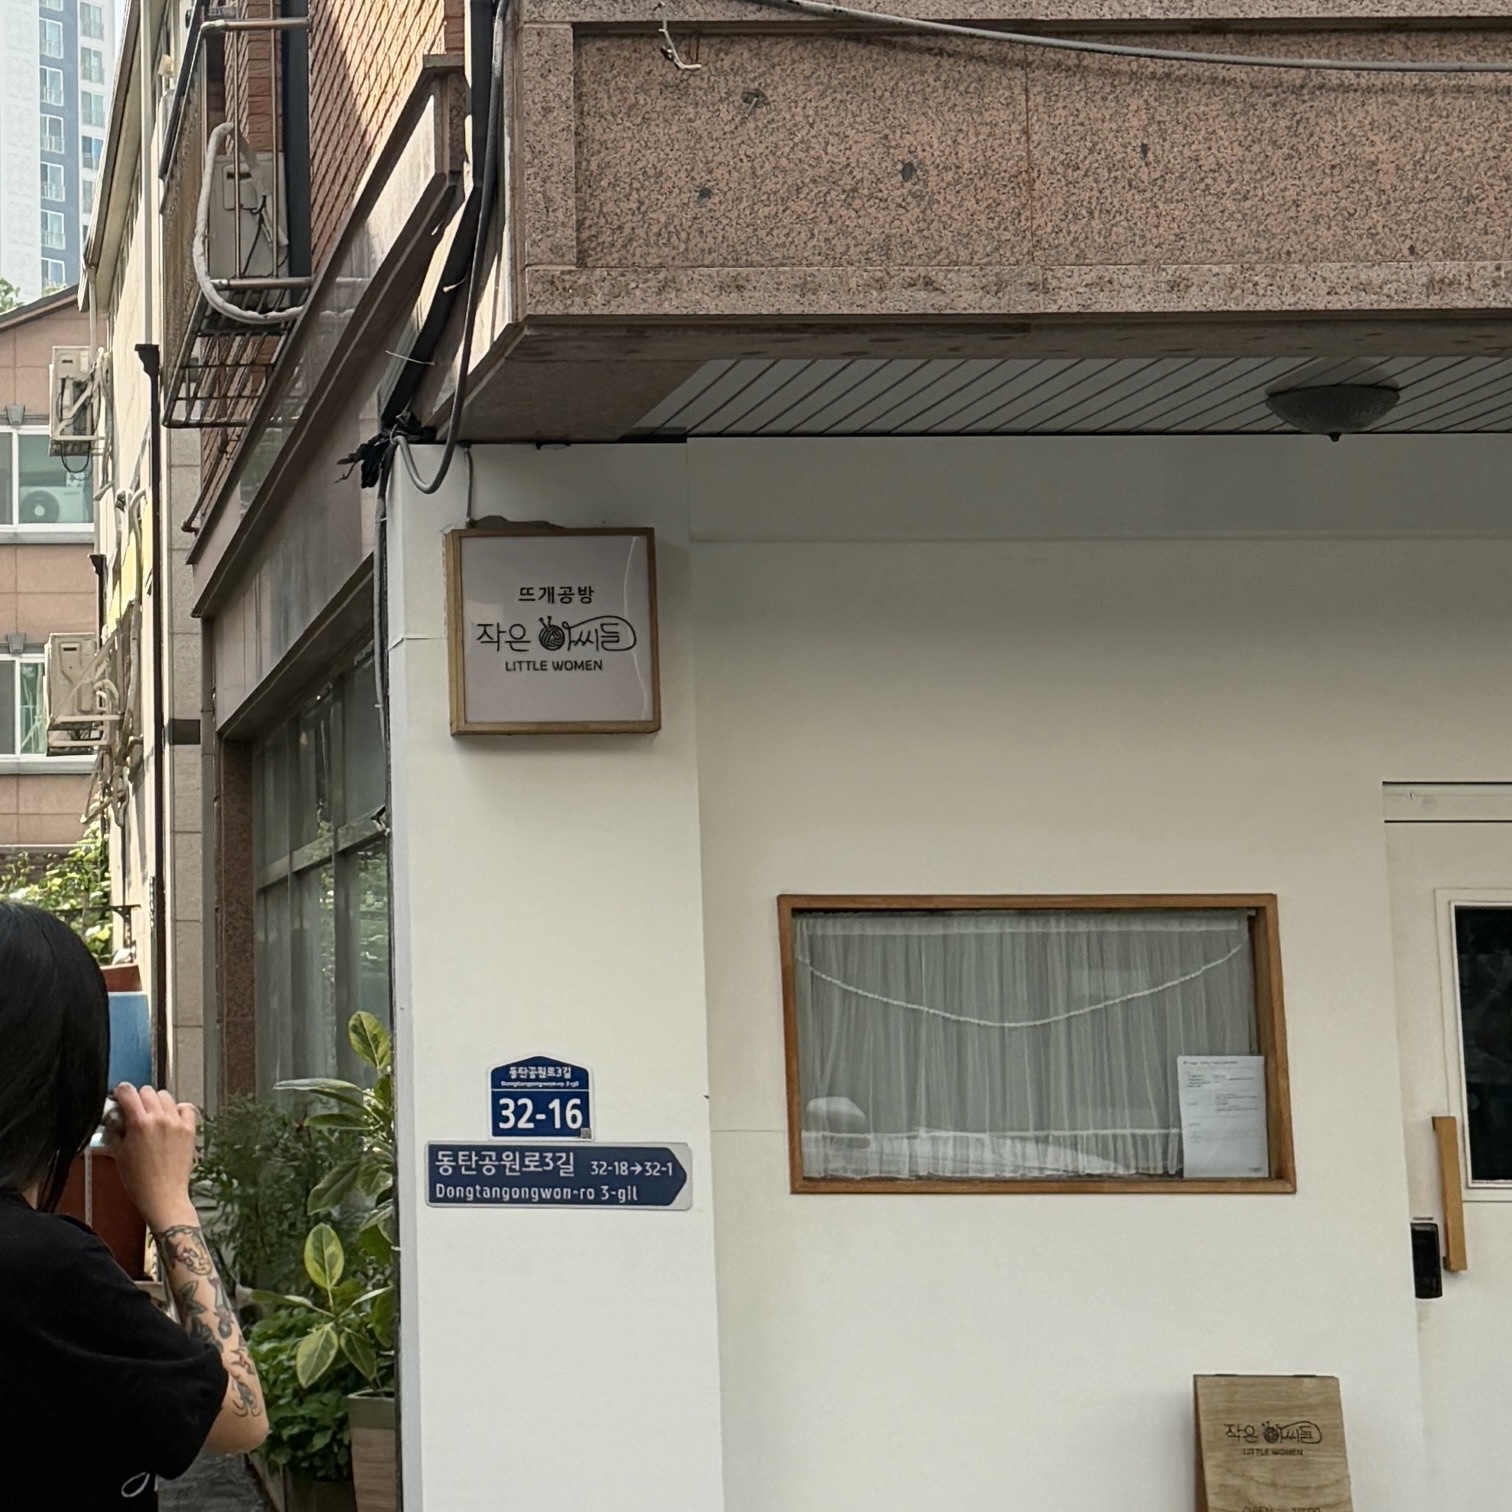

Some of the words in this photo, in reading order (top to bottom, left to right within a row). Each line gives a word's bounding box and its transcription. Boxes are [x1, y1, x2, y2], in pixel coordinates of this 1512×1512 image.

[518, 586, 594, 604] 뜨개공방
[476, 623, 531, 652] 작은
[505, 661, 548, 672] LITTLE
[552, 660, 603, 671] WOMEN
[498, 1098, 583, 1129] 32-16
[435, 1151, 575, 1177] 동탄공원로3길
[590, 1161, 629, 1176] 32-18
[644, 1162, 673, 1177] 32-1
[435, 1183, 595, 1202] Dongtangongwon-ro
[600, 1185, 638, 1203] 3-gil
[1224, 1424, 1258, 1443] 작은
